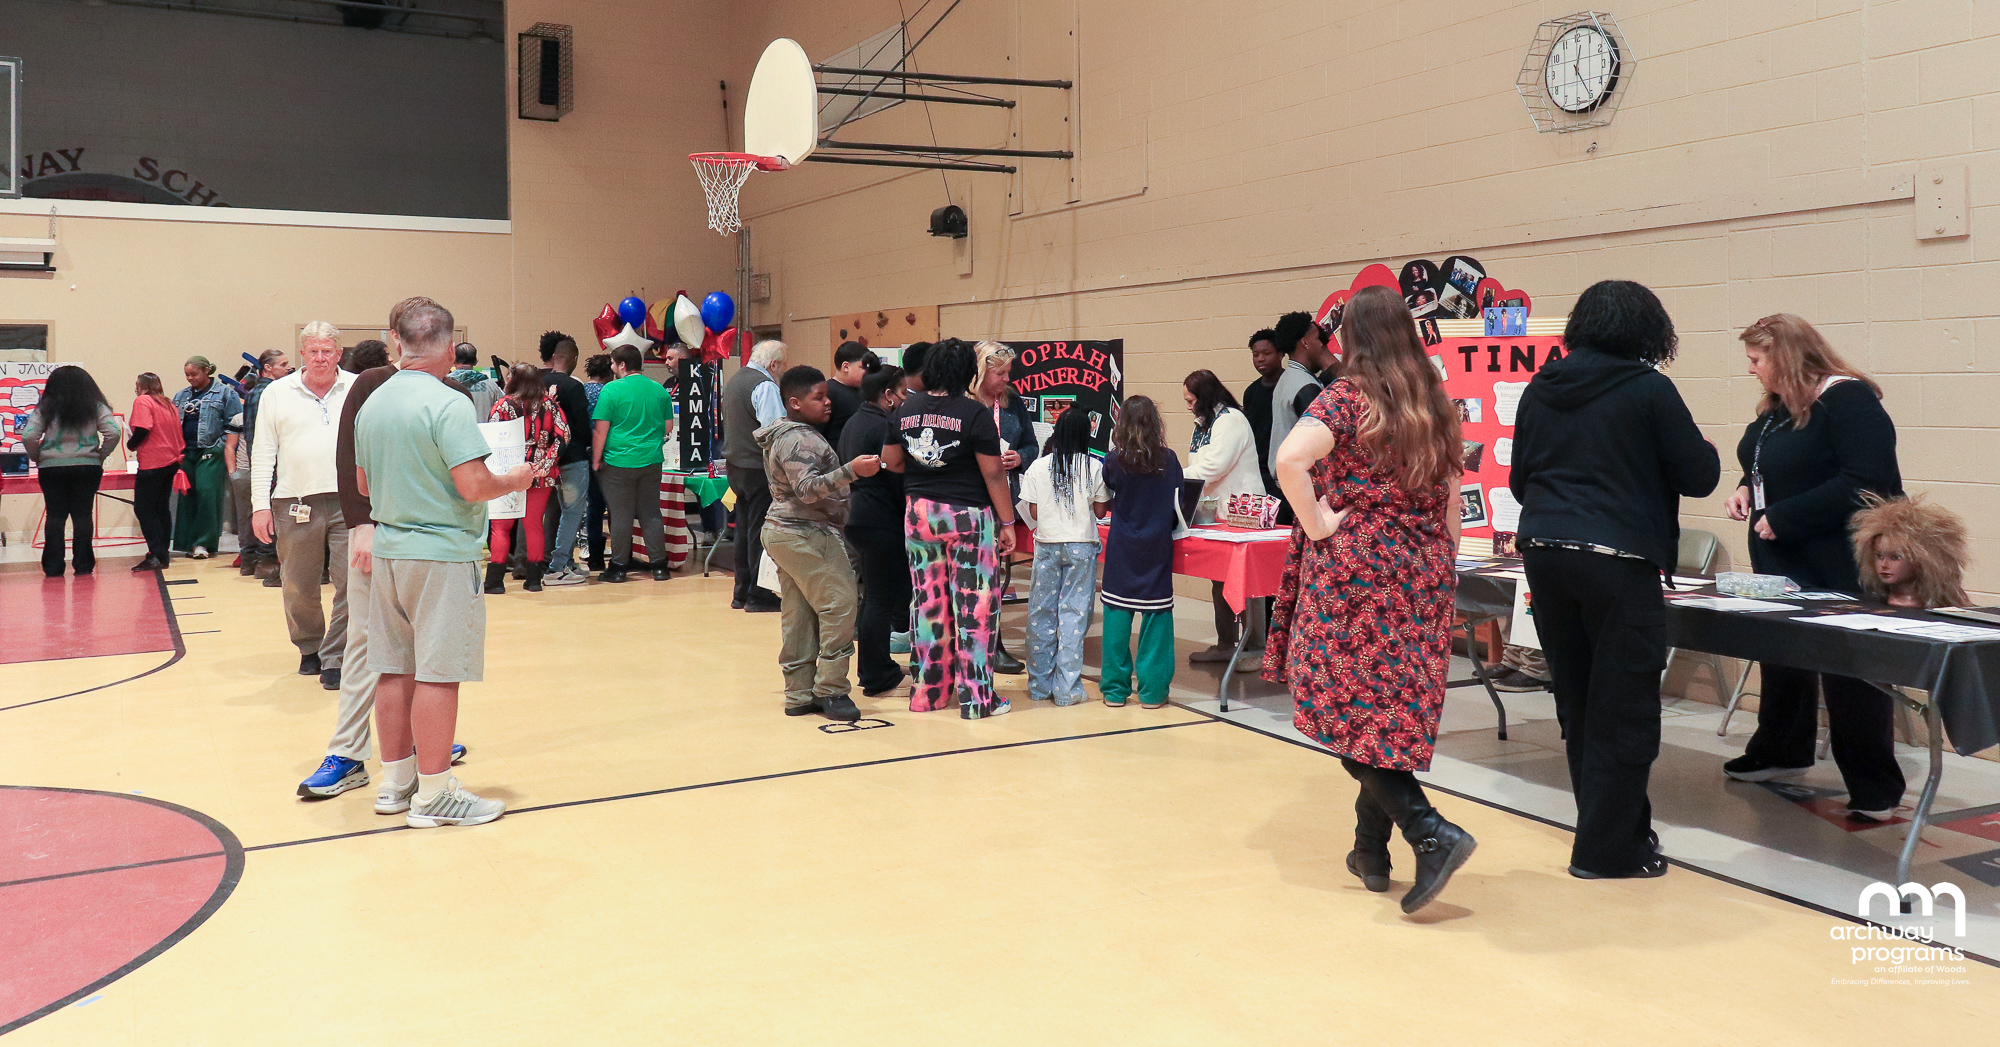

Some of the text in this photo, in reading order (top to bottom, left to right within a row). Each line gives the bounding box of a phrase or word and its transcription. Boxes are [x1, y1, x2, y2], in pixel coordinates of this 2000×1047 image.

[1574, 33, 1581, 43] 12
[1562, 41, 1568, 50] 11
[1597, 44, 1603, 53] 2
[1553, 54, 1560, 63] 10
[133, 157, 231, 207] SCH
[1021, 341, 1108, 371] OPRAH
[18, 363, 59, 375] JACK
[1012, 366, 1108, 395] WINFREY
[689, 364, 703, 461] KAMALA
